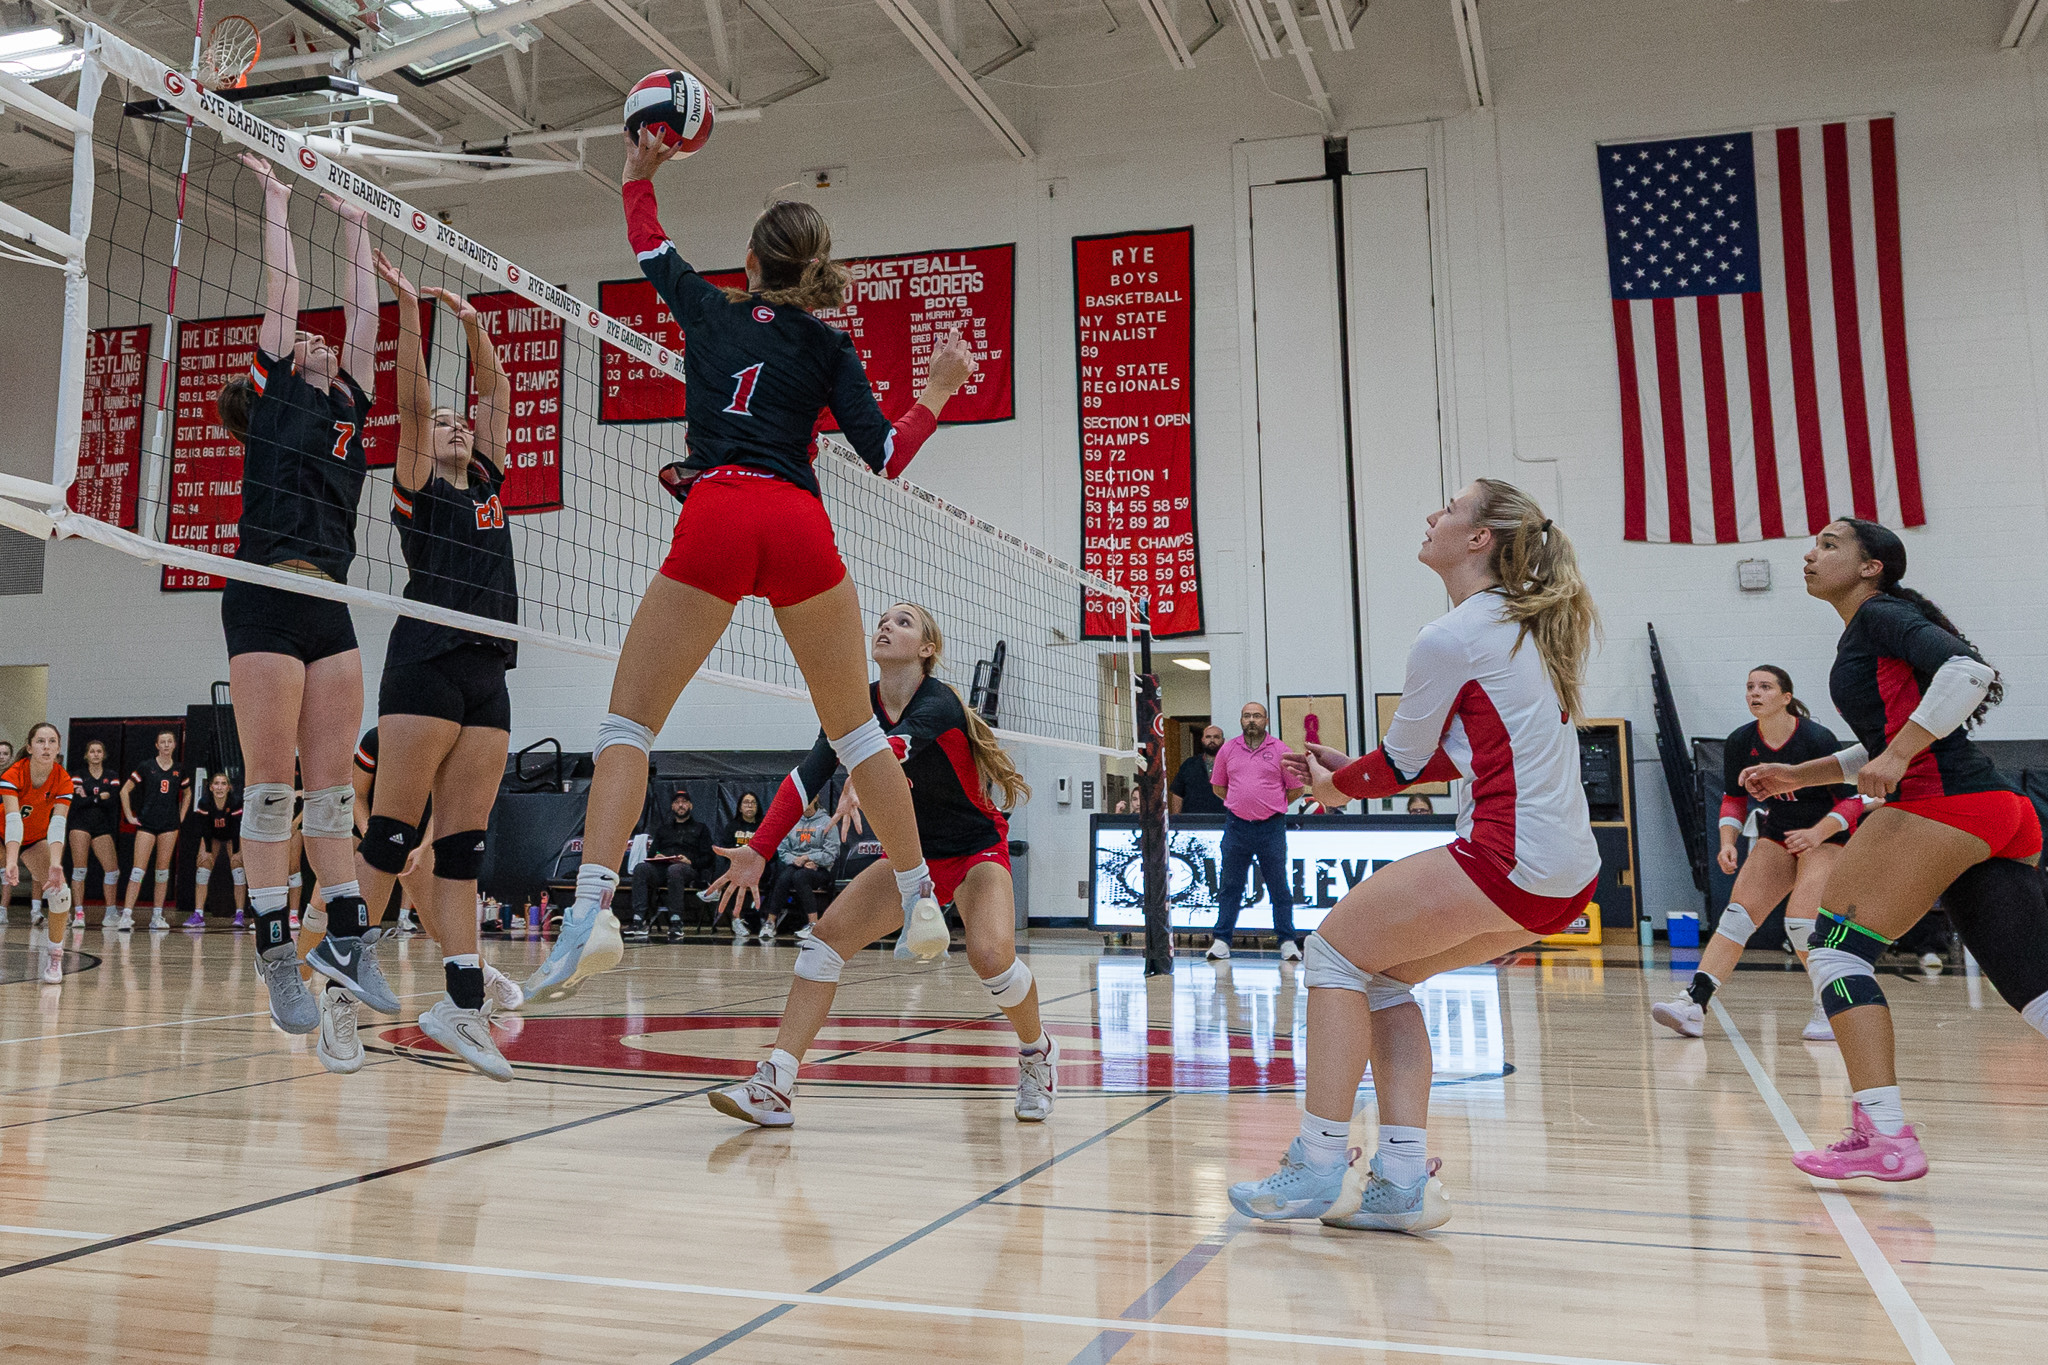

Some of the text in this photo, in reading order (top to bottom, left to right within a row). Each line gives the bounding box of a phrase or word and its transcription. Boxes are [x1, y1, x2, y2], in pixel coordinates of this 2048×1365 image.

[689, 78, 701, 123] SPALDING
[200, 93, 224, 118] RYE
[227, 105, 286, 153] GARNETS
[328, 163, 351, 190] RYE
[352, 177, 402, 219] GARNETS
[436, 223, 456, 248] RYE
[457, 236, 499, 272] GARNETS
[528, 276, 545, 298] RYE
[545, 286, 581, 317] GARNETS
[606, 321, 620, 340] RYE
[621, 329, 653, 356] GARNETS
[1112, 247, 1154, 266] RYE
[858, 278, 903, 302] POINT
[909, 271, 984, 298] SCORERS
[1110, 271, 1158, 287] BOYS
[925, 296, 968, 310] BOYS
[1085, 290, 1182, 308] BASKETBALL
[752, 305, 775, 323] G
[910, 313, 924, 322] TIM
[926, 310, 956, 320] MURPHY
[1080, 310, 1167, 327] NY STATE
[910, 323, 932, 333] MARK
[1081, 327, 1157, 342] FINALIST
[182, 325, 261, 349] RYE ICE HOCKEY
[911, 334, 931, 344] GREG
[524, 339, 558, 362] FIELD
[912, 344, 932, 355] PETE
[1081, 346, 1099, 358] 89
[181, 354, 216, 371] SECTION
[1082, 363, 1168, 378] NY STATE
[515, 369, 560, 392] CHAMPS
[1083, 377, 1181, 393] REGIONALS
[722, 361, 765, 417] 1
[515, 398, 558, 417] 87 95
[1083, 396, 1102, 408] 89
[1083, 413, 1191, 429] SECTION 1 OPEN
[178, 426, 203, 441] STATE
[332, 420, 356, 461] 7
[515, 424, 556, 443] 01 02
[1083, 432, 1150, 446] CHAMPS
[517, 449, 555, 468] 08 11
[1084, 450, 1126, 462] 59 72
[1084, 468, 1169, 483] SECTION 1
[177, 481, 205, 497] STATE
[1085, 485, 1151, 499] CHAMPS
[1085, 497, 1189, 514] 53 54 55 58 59
[1086, 516, 1170, 530] 61 72 89 20
[171, 525, 209, 540] LEAGUE
[1085, 532, 1194, 551] LEAGUE CHAMPS
[1085, 550, 1195, 566] 50 52 53 54 55
[167, 575, 210, 586] 11 13 20
[1130, 569, 1148, 582] 58
[1155, 568, 1174, 581] 59
[1180, 564, 1195, 578] 61
[1130, 579, 1197, 597] 73 74 93
[1086, 600, 1104, 612] 05
[1158, 601, 1174, 613] 20
[160, 779, 170, 794] 9
